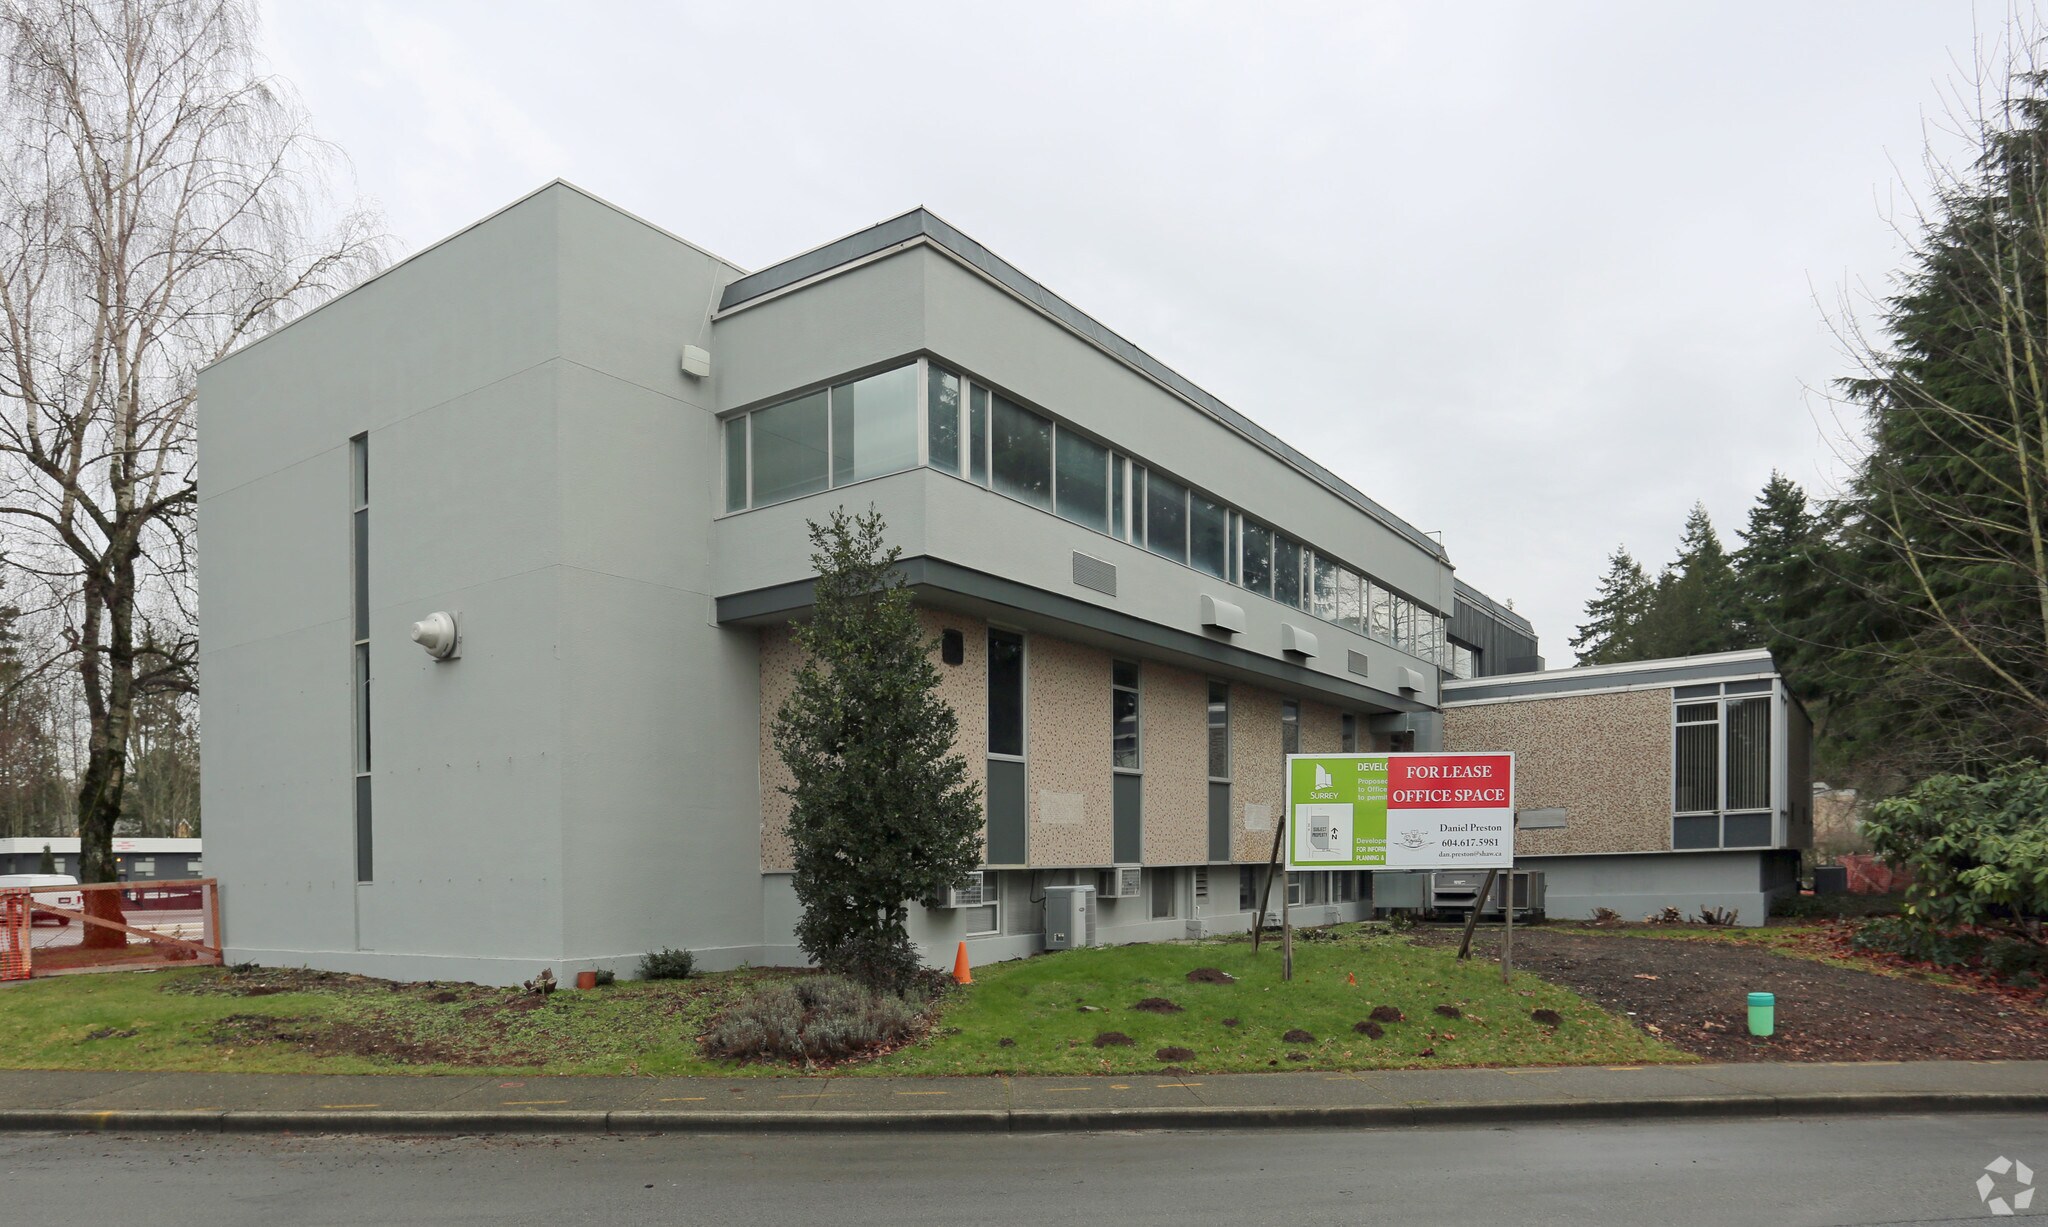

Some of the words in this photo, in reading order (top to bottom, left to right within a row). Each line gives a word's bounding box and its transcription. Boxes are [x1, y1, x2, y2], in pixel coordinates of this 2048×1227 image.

[1406, 766, 1440, 779] FOR
[1443, 765, 1492, 778] LEASE
[1392, 789, 1452, 802] OFFICE
[1454, 788, 1505, 802] SPACE
[1440, 823, 1468, 832] Daniel
[1470, 823, 1502, 832] Preston
[1441, 838, 1499, 847] 604.617.5981
[1438, 851, 1502, 859] dan.preston@shaw.ca
